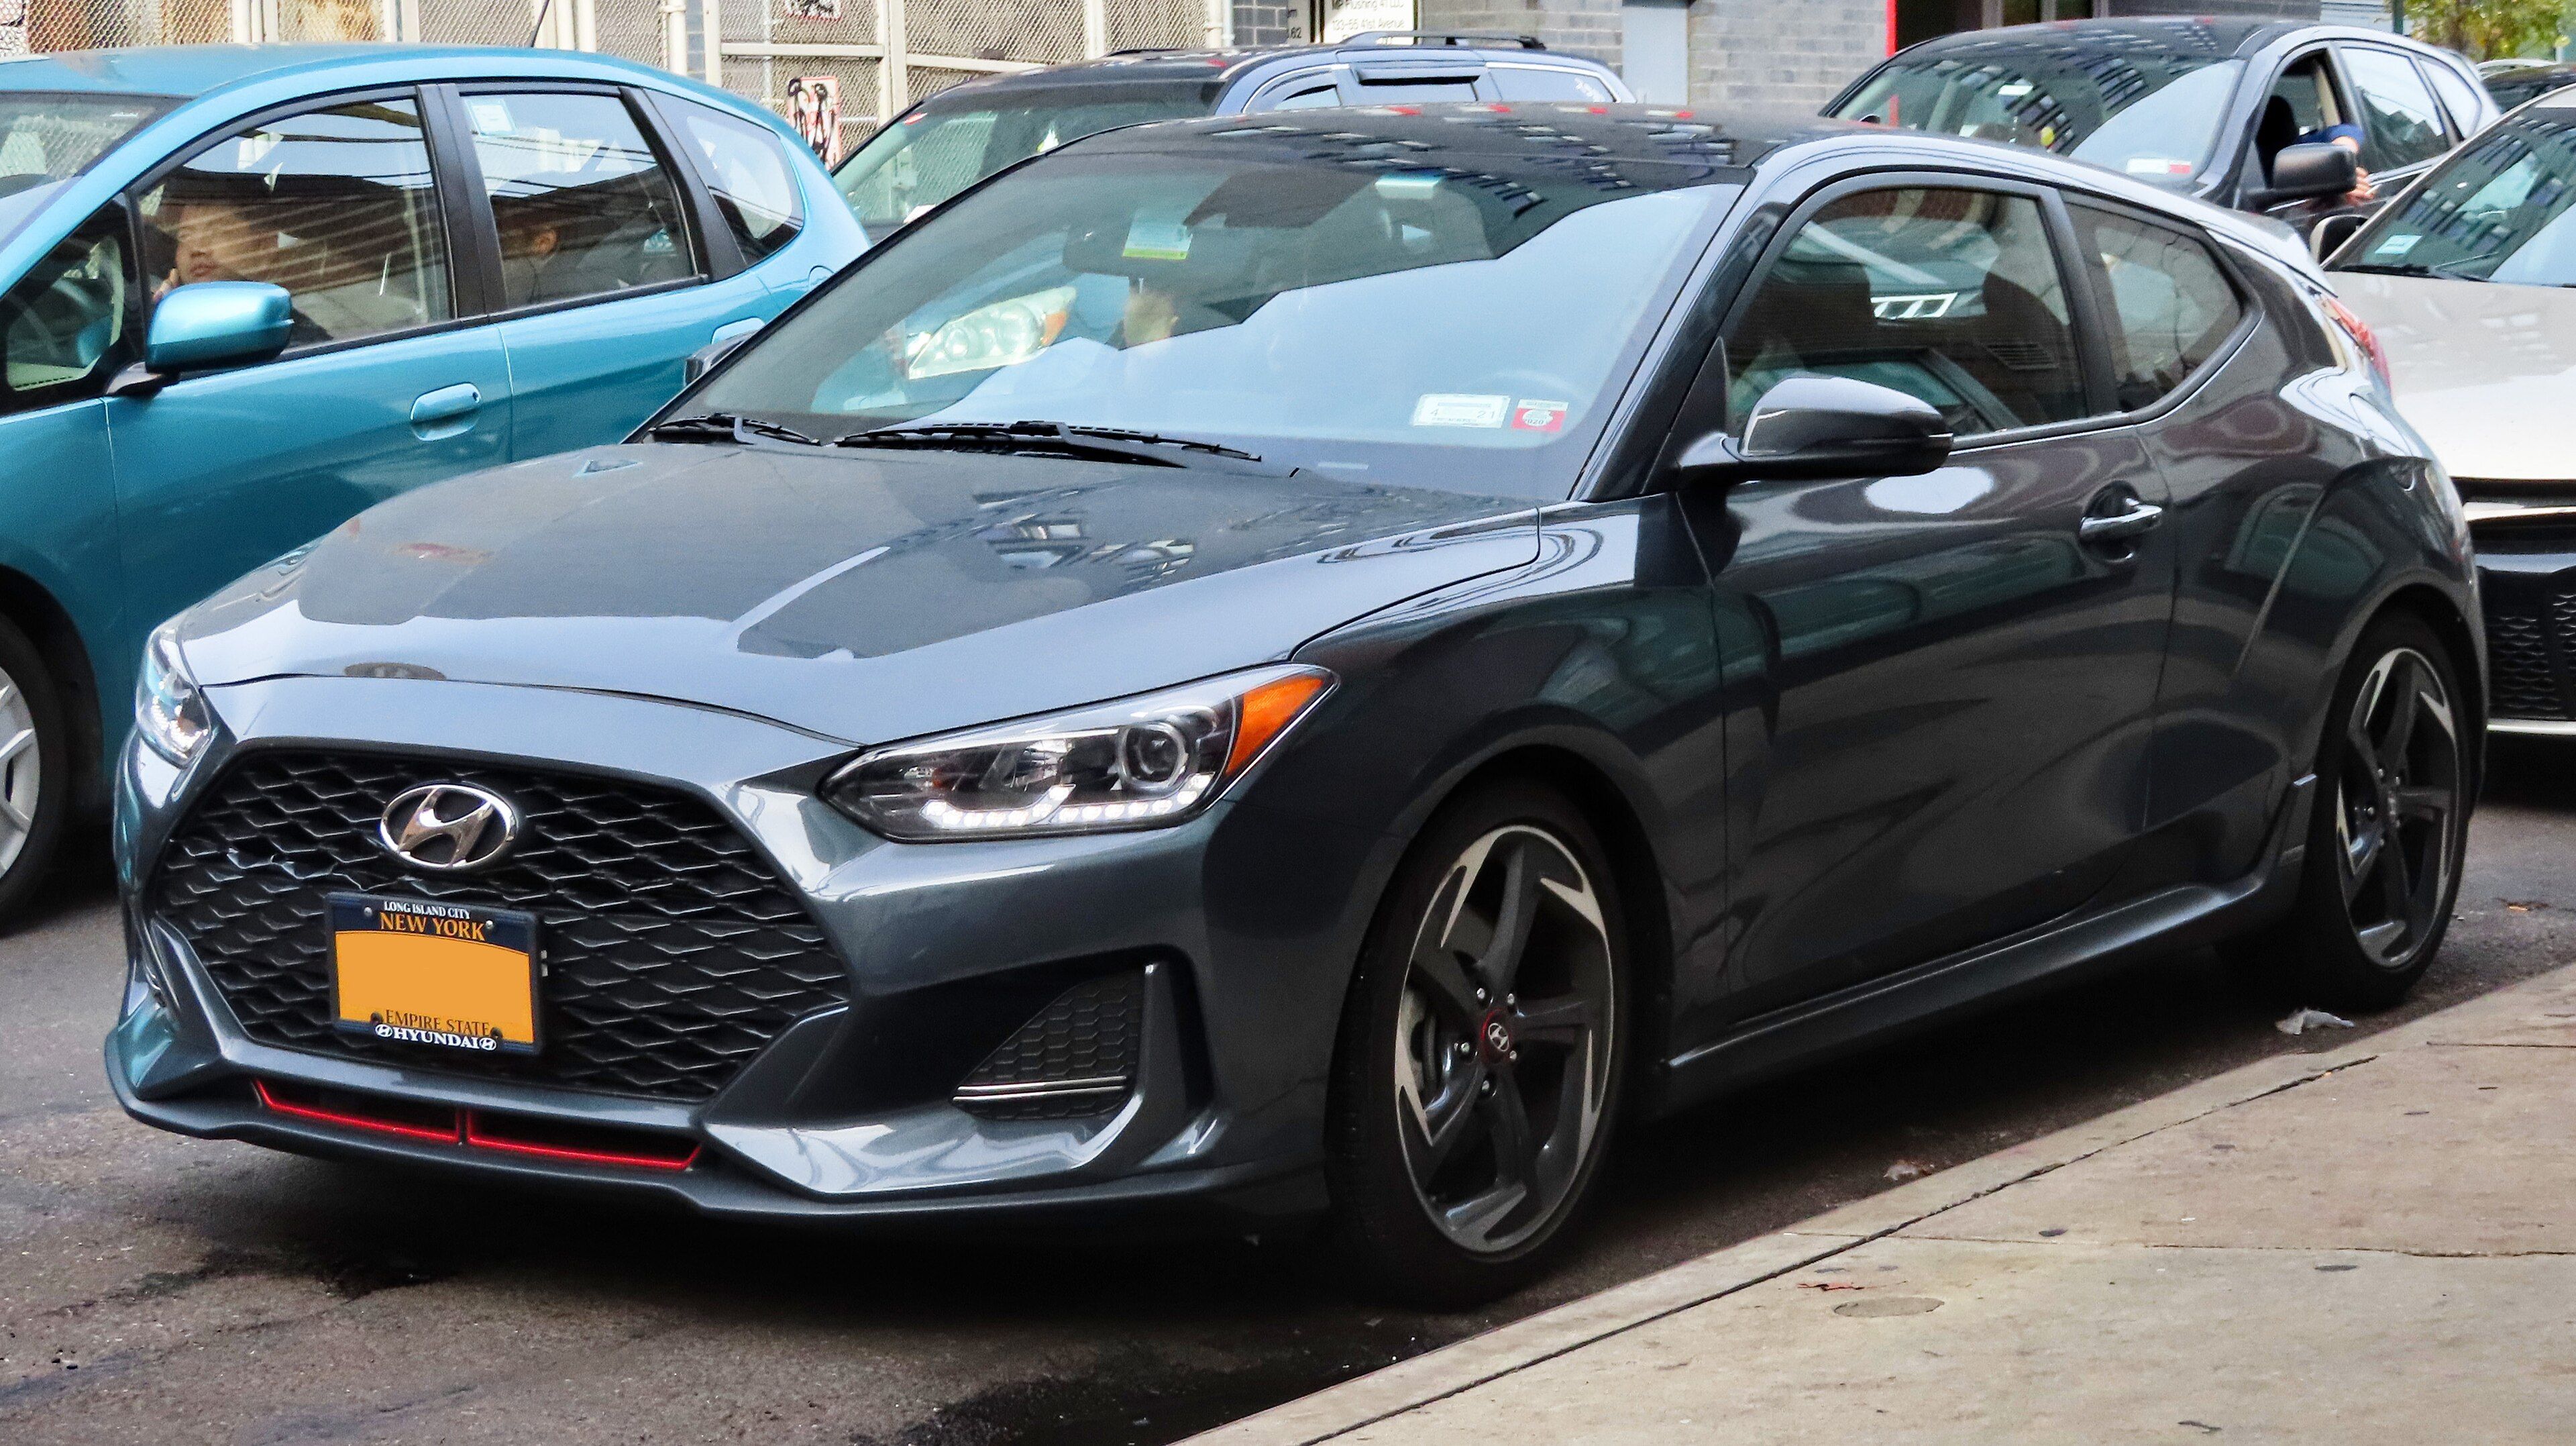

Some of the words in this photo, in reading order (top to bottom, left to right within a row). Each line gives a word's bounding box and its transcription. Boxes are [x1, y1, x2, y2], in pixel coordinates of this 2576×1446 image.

[384, 901, 411, 914] LONG
[413, 905, 445, 917] ISLAND
[447, 908, 471, 920] CITY
[380, 912, 427, 933] NEW
[432, 918, 486, 941] YORK
[385, 1009, 441, 1031] EMPIRE
[447, 1019, 490, 1037] STATE
[394, 1029, 480, 1049] HYUNDAI
